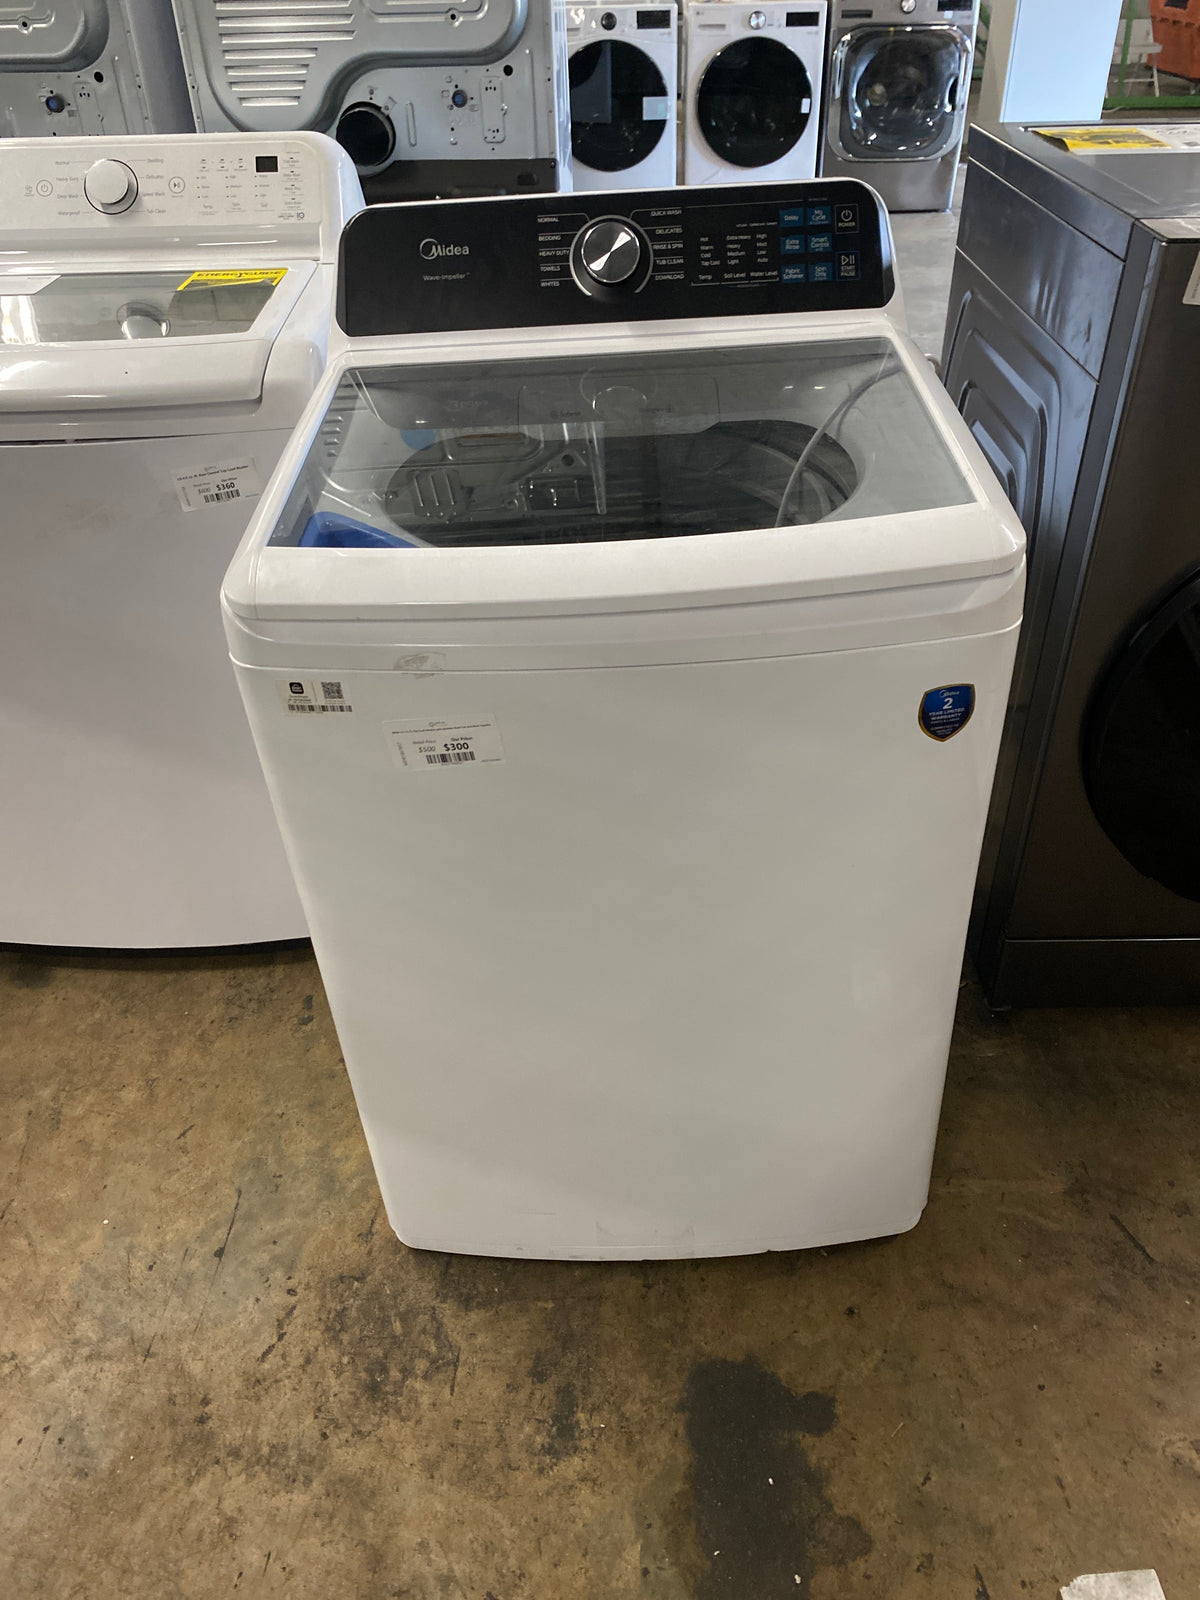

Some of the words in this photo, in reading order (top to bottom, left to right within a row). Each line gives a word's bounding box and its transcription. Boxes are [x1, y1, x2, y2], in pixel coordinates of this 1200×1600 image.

[420, 238, 470, 260] Midea
[655, 273, 684, 281] DOWNLOAD
[216, 482, 235, 491] $360
[943, 697, 953, 710] 2
[443, 742, 469, 752] $300
